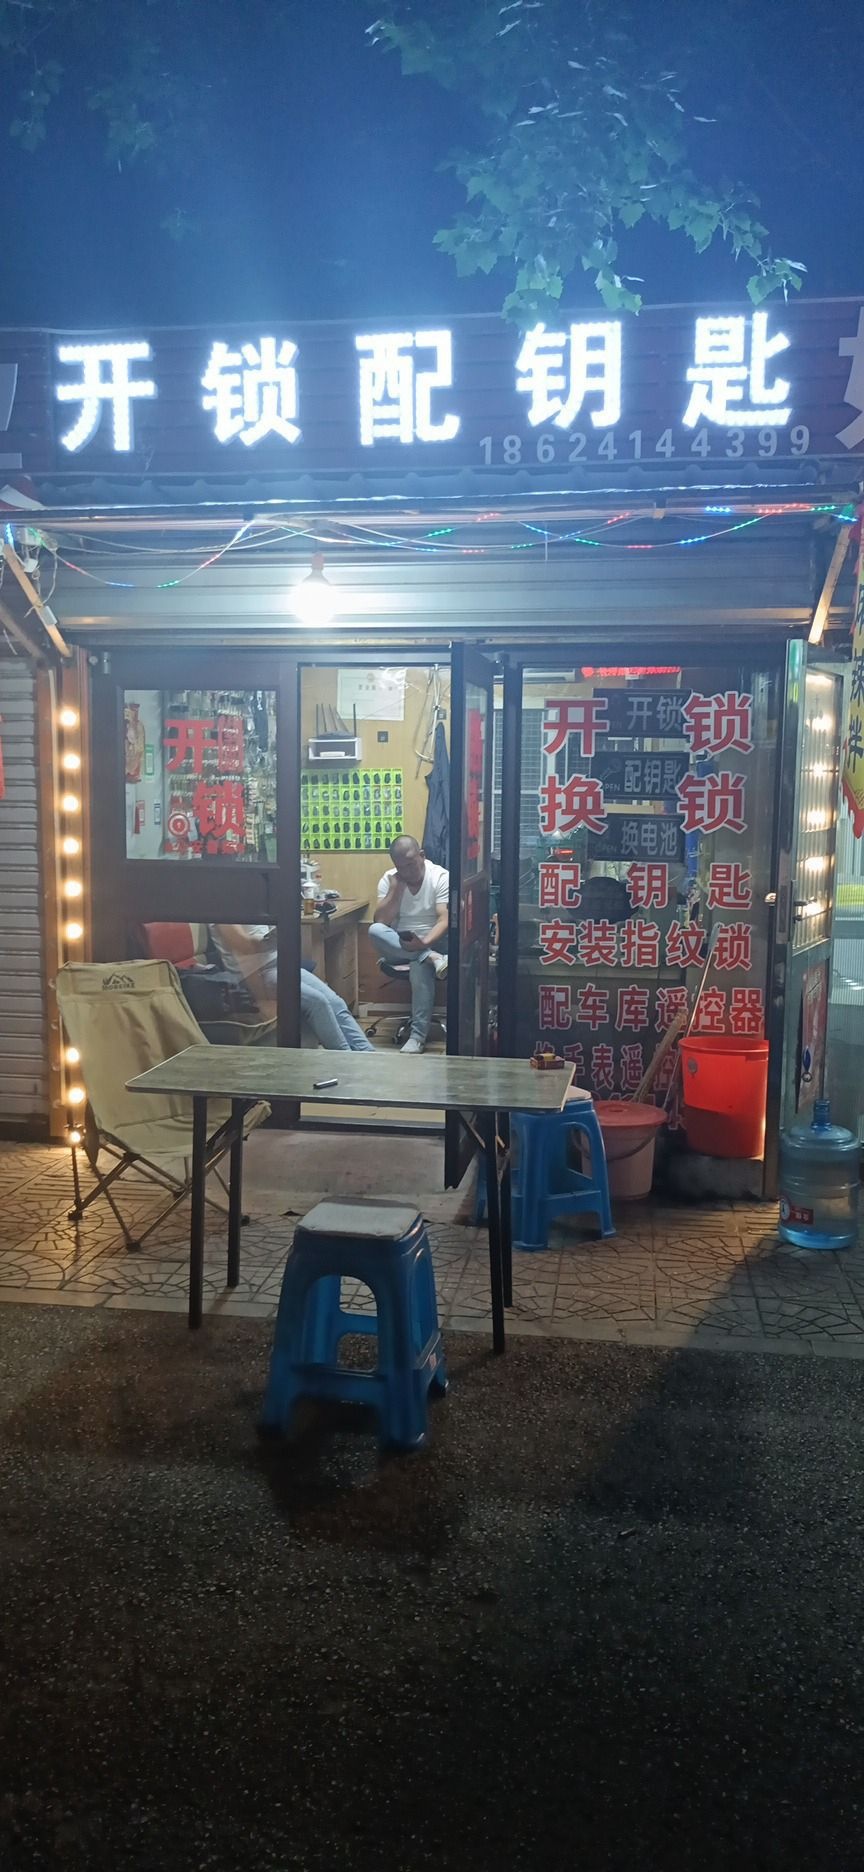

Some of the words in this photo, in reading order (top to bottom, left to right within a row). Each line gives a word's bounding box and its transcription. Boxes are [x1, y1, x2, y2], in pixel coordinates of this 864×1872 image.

[56, 312, 792, 452] 开锁配钥匙
[479, 425, 811, 465] 18624144399
[543, 691, 752, 756] 开锁
[626, 696, 682, 731] 开锁
[624, 759, 682, 793] 配钥匙
[538, 771, 747, 834] 换锁
[621, 820, 678, 857] 换电池
[538, 862, 752, 910] 配钥匙
[538, 918, 752, 970] 安装指纹锁
[538, 982, 764, 1034] 配车库遥控器
